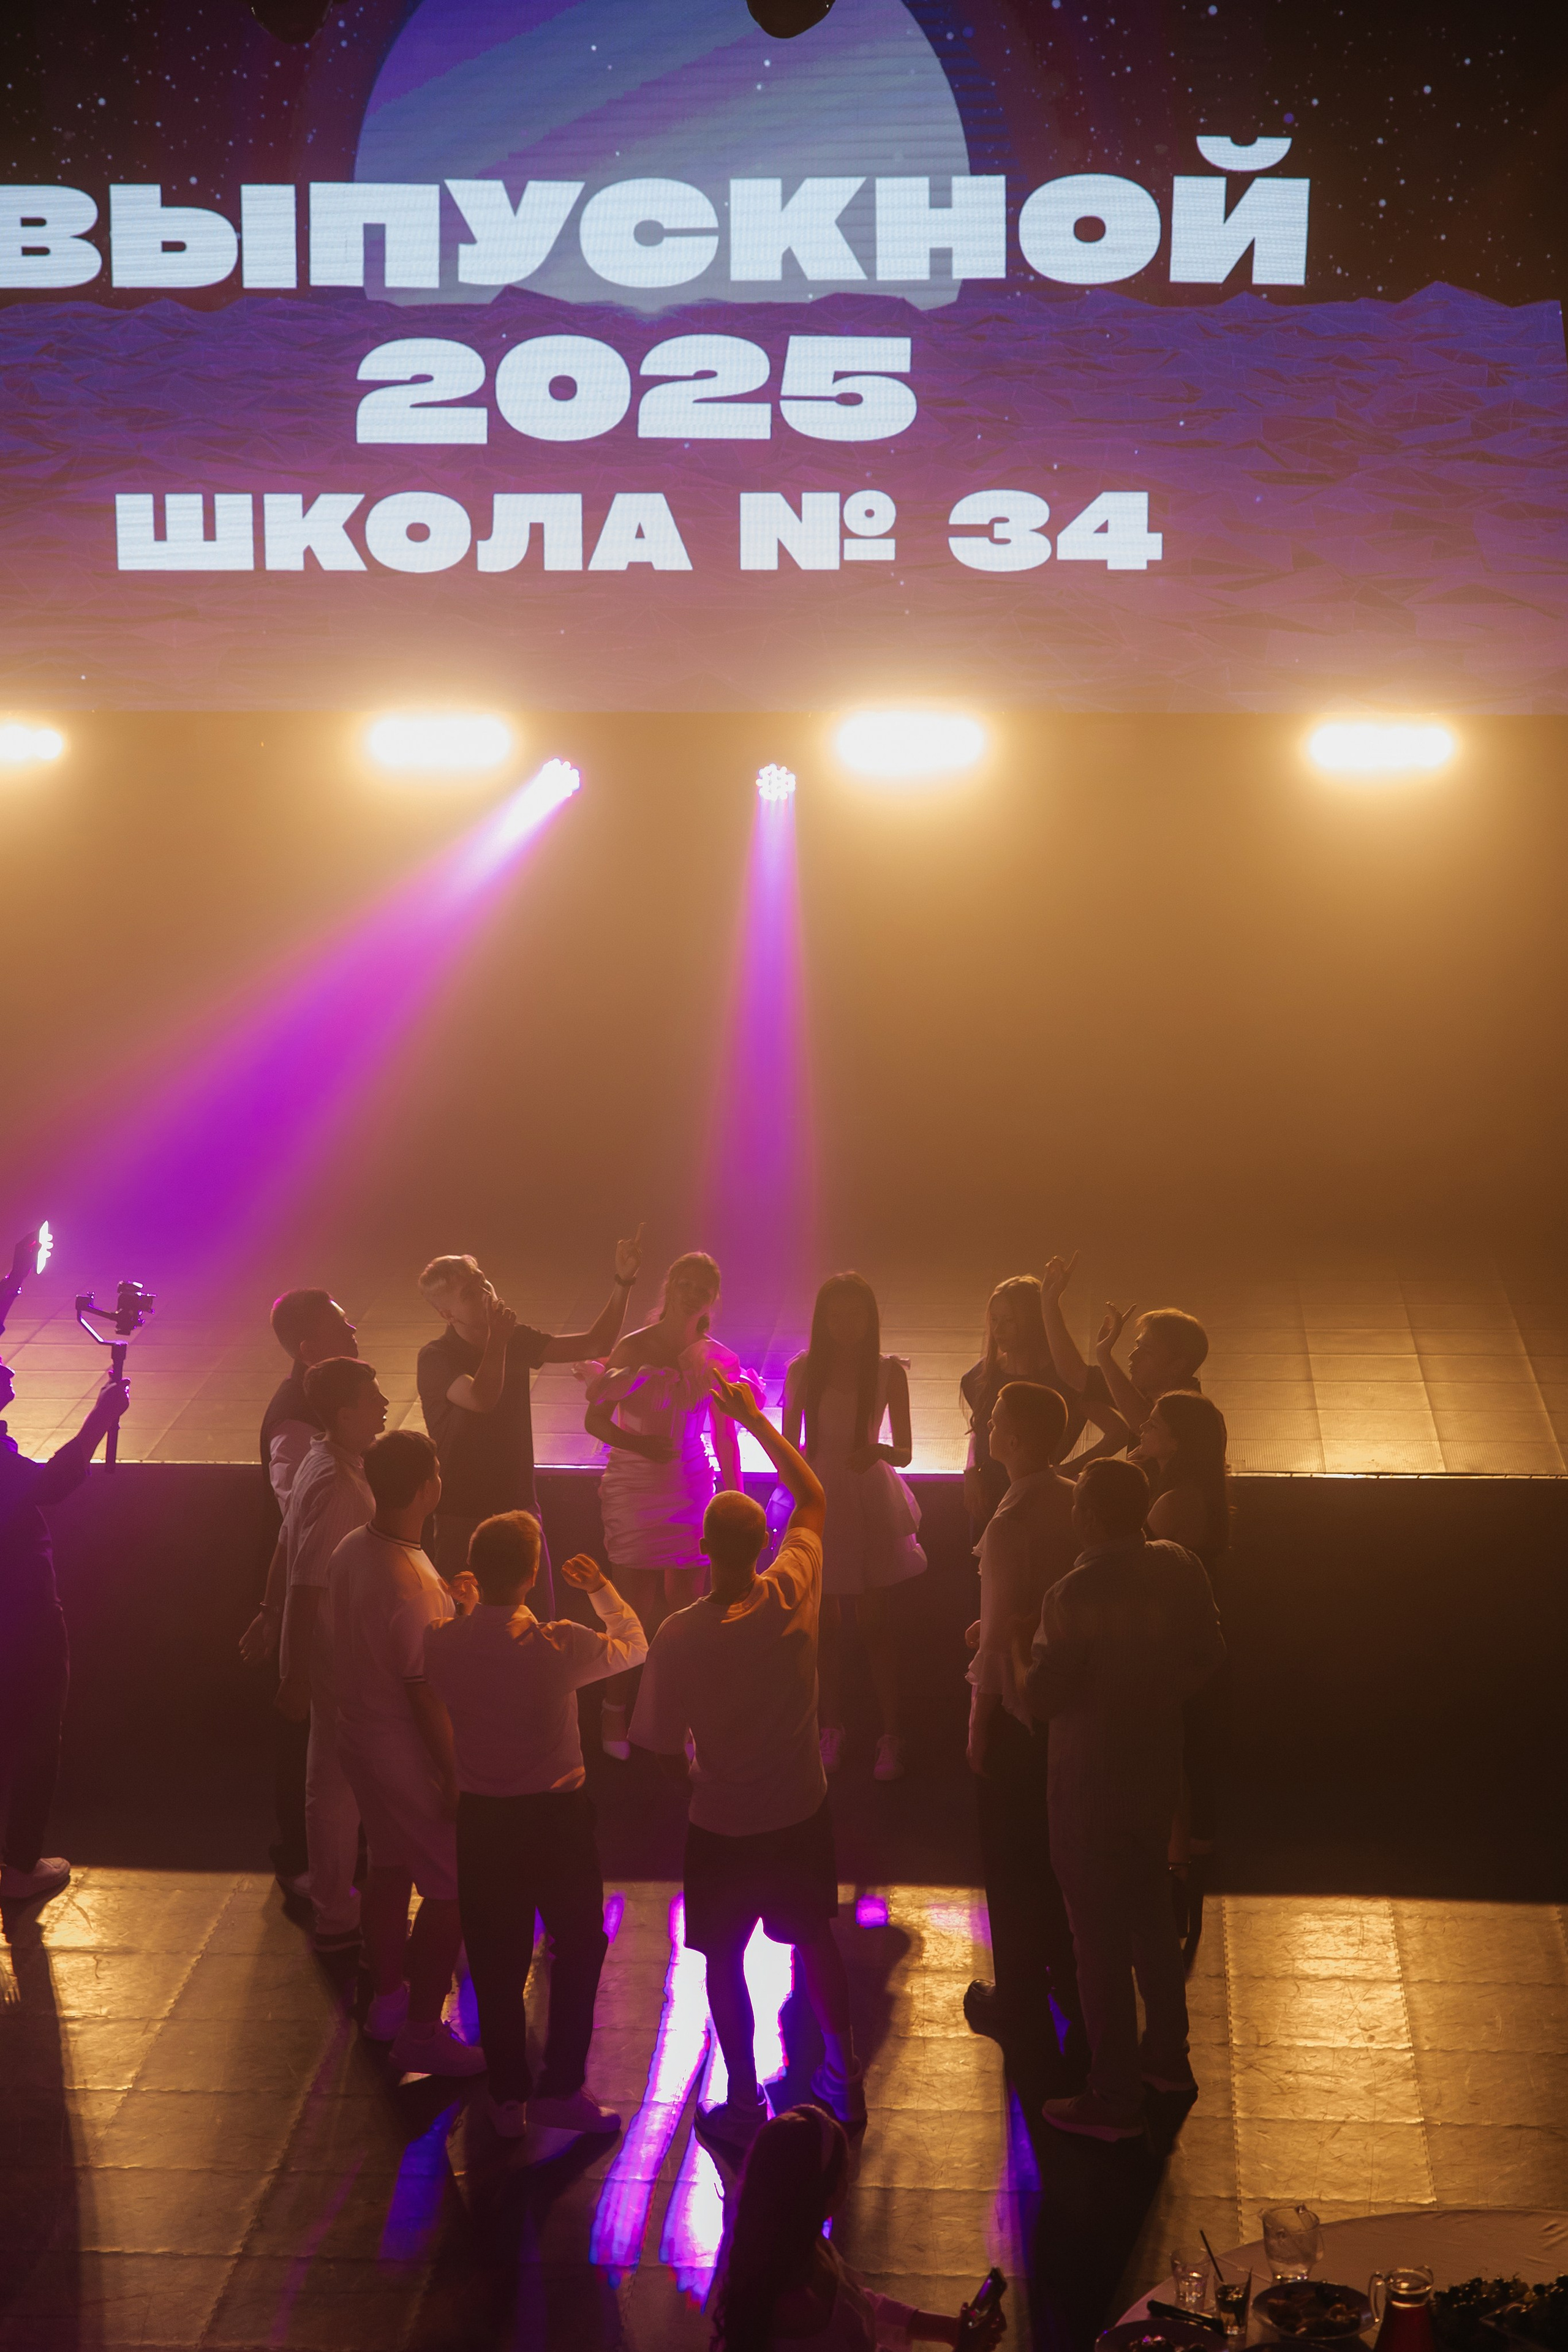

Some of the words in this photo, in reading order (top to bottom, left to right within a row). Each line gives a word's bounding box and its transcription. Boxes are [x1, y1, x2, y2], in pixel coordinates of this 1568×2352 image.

[0, 137, 1310, 289] ВЫПУСКНОЙ
[356, 334, 918, 445] 2025
[115, 491, 693, 574] ШКОЛА
[739, 489, 897, 571] №
[948, 489, 1163, 573] 34
